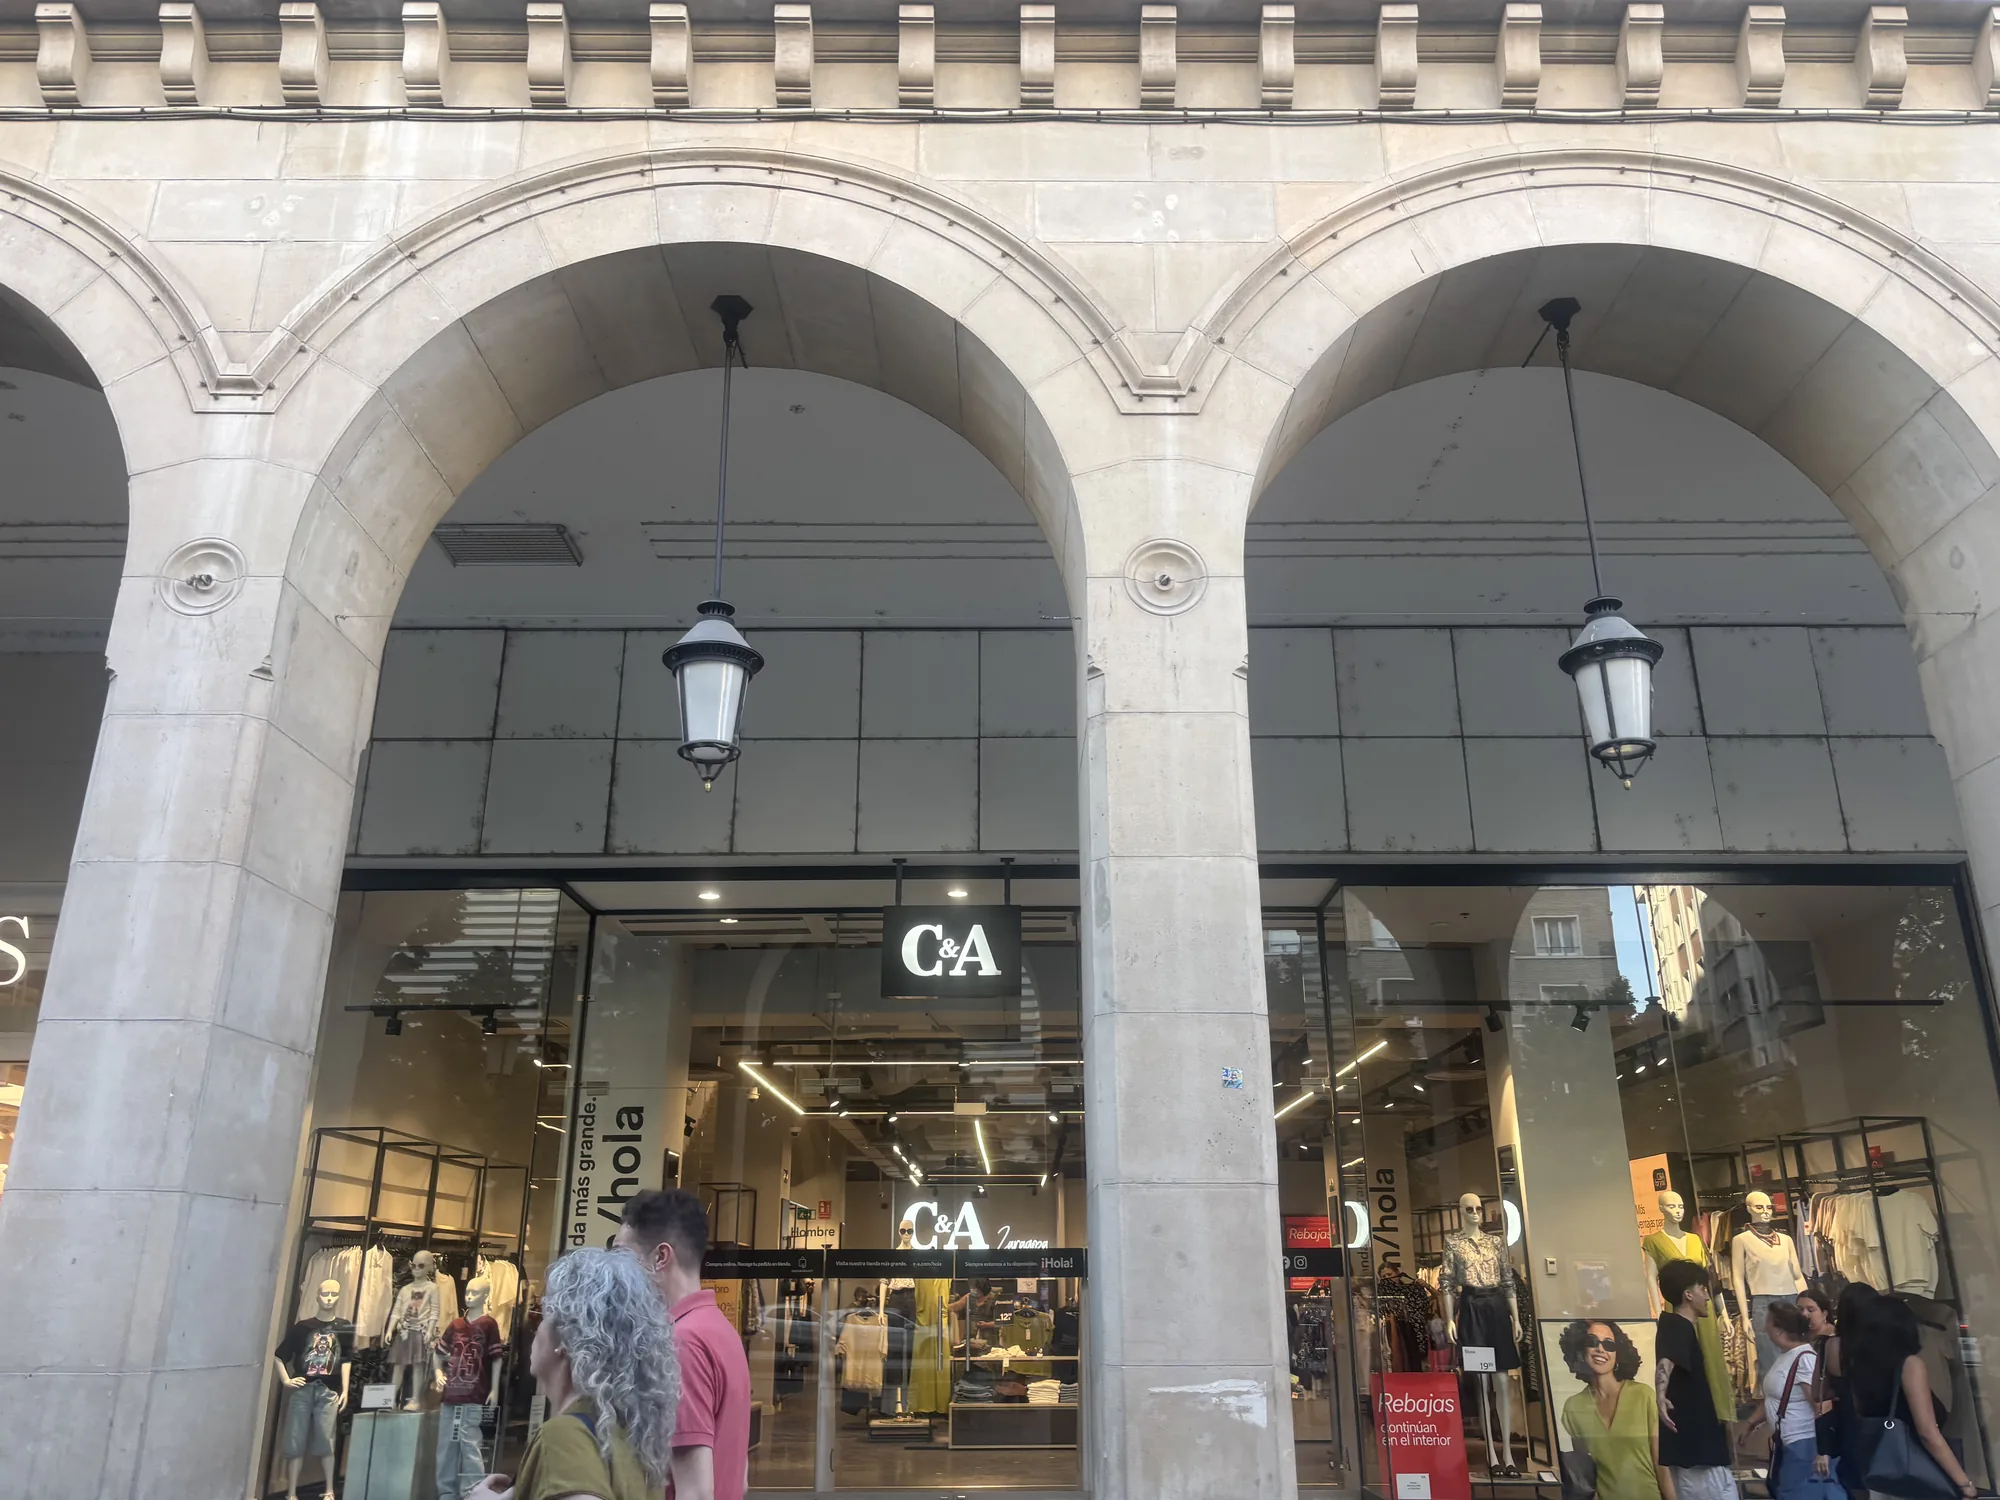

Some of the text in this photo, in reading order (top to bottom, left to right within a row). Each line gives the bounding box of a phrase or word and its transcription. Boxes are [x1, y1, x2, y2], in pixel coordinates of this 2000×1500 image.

[902, 924, 1002, 977] C&A
[578, 1097, 597, 1171] grande.
[597, 1105, 645, 1250] /hola
[572, 1176, 590, 1217] más
[790, 1226, 836, 1237] Hombre
[902, 1201, 990, 1250] C&A
[1289, 1228, 1331, 1242] Rebajas
[1041, 1257, 1074, 1269] ¡Hola!
[1378, 1392, 1455, 1418] Rebajas
[1380, 1421, 1438, 1434] continúan
[1381, 1433, 1452, 1446] en el interior
